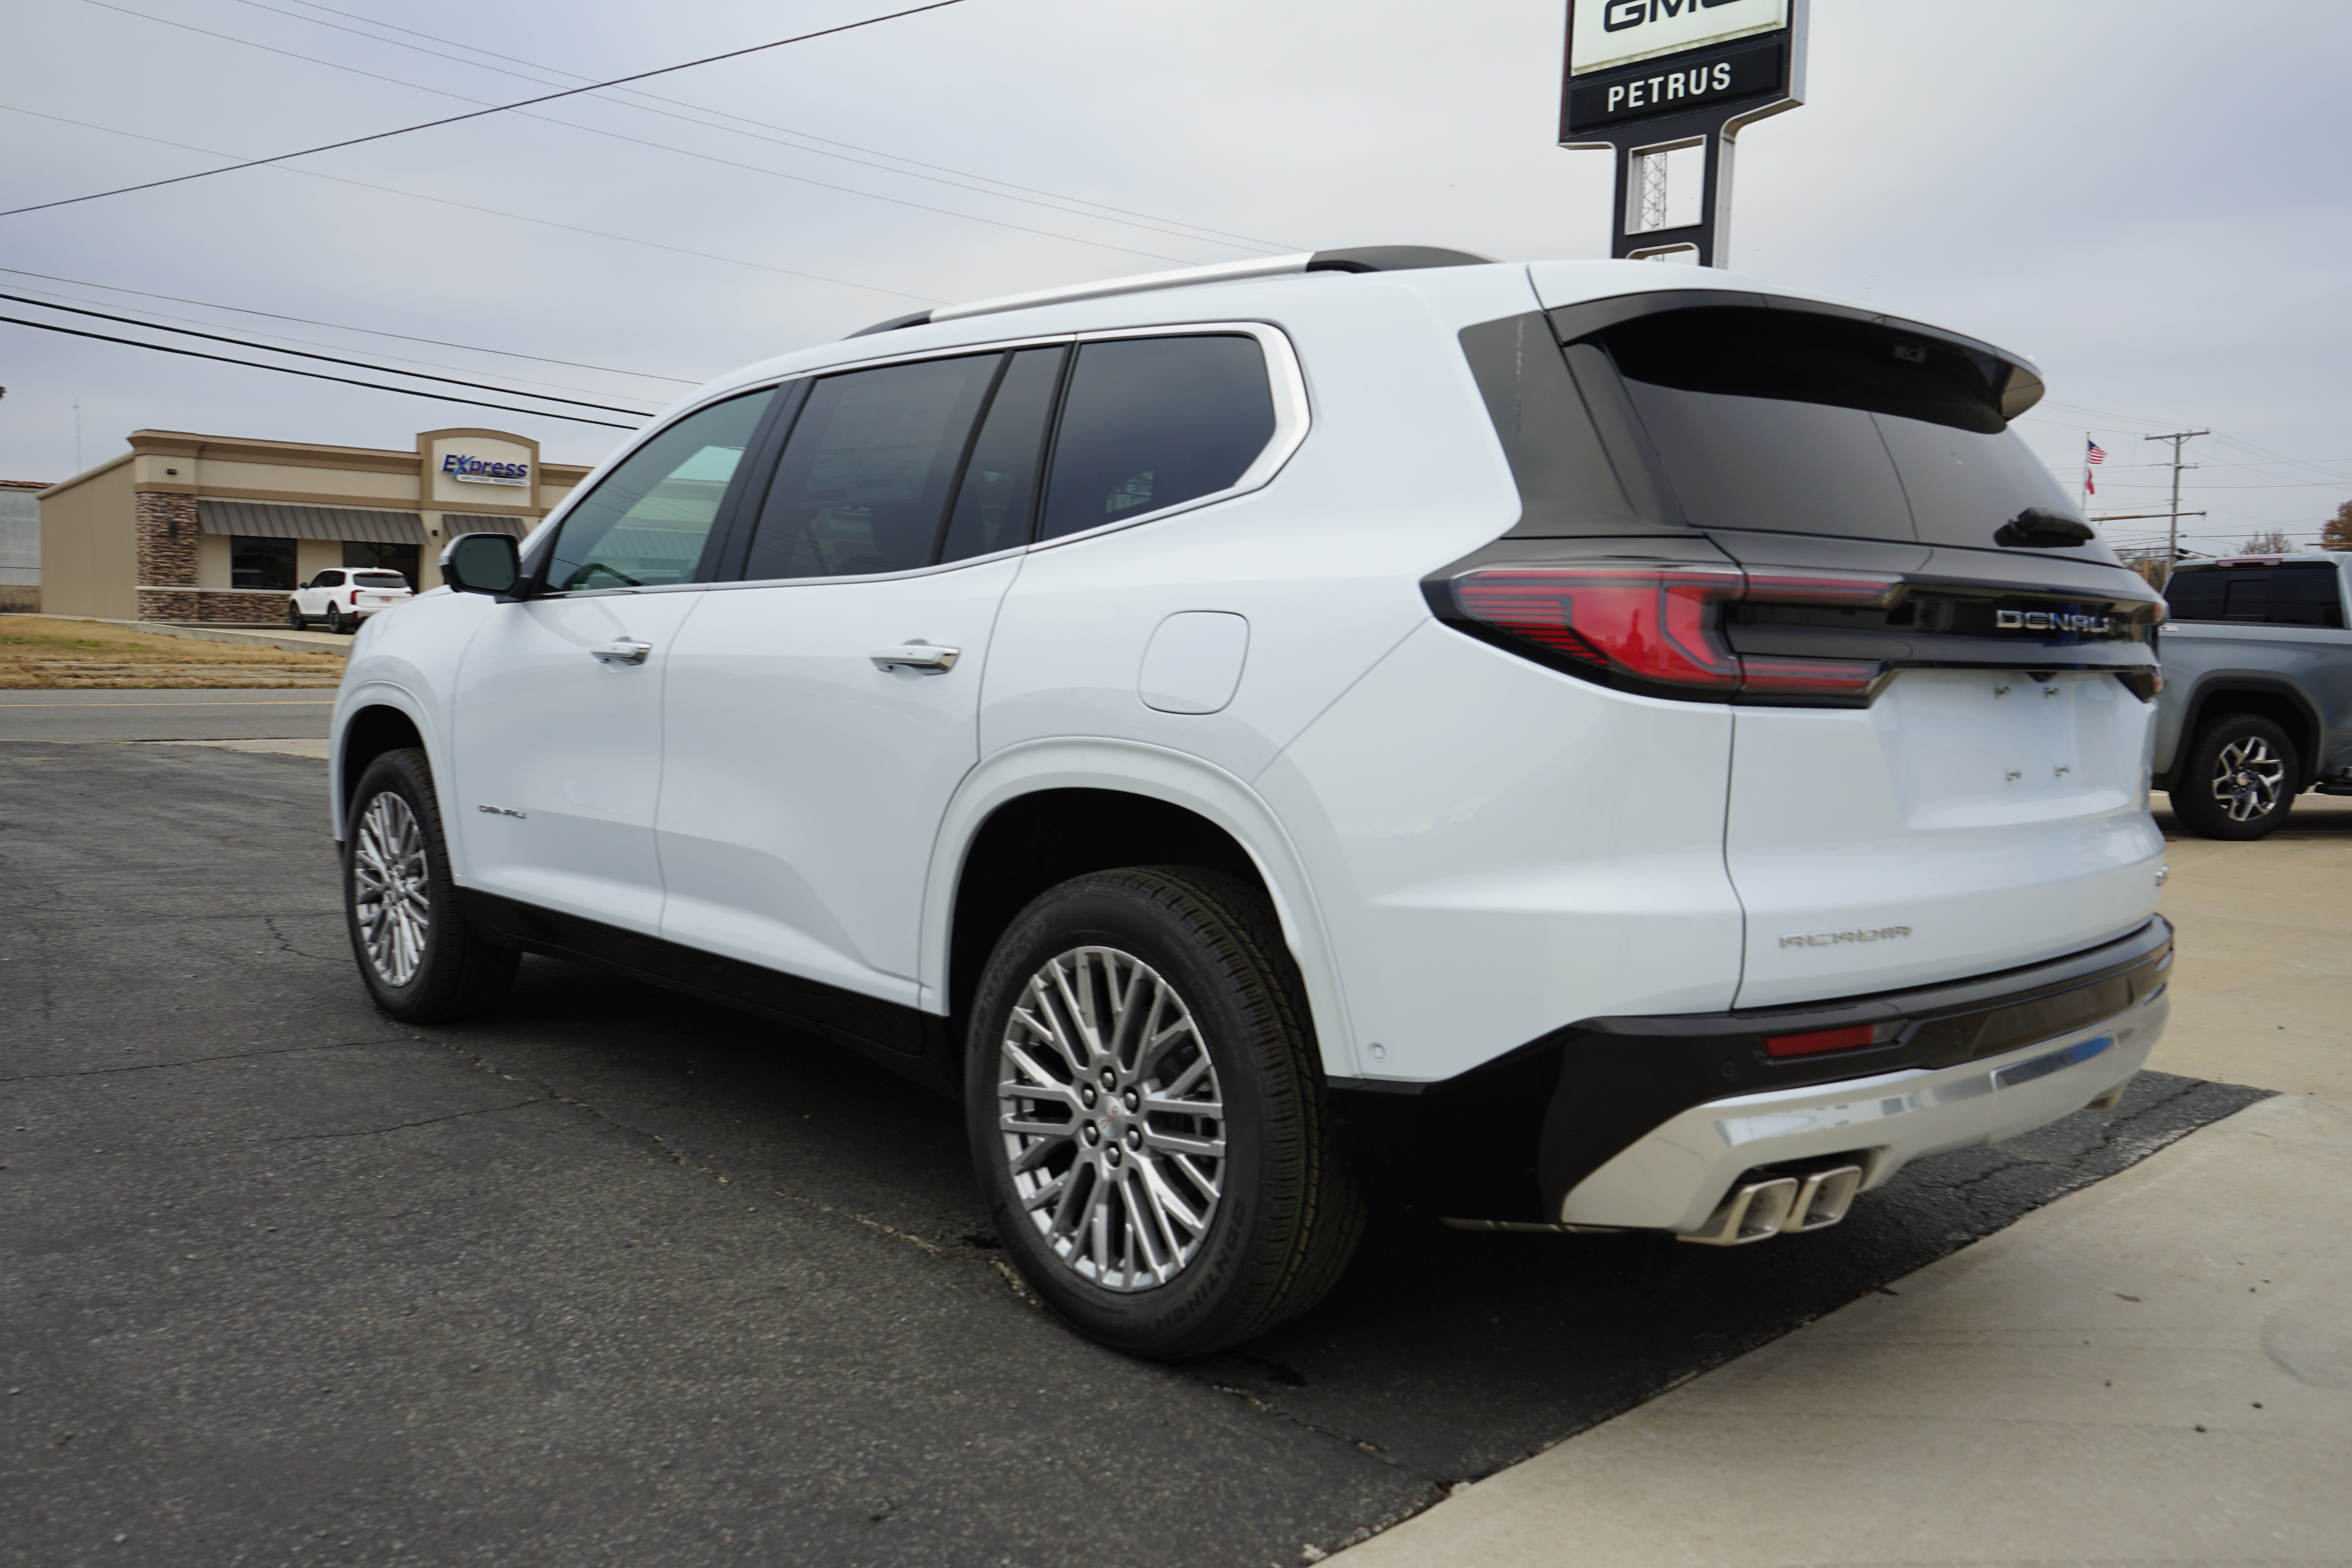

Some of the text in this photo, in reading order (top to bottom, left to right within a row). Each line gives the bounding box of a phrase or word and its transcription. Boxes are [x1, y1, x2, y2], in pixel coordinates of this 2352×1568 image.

[1604, 0, 1743, 33] GM
[1608, 63, 1731, 112] PETRUS
[1996, 610, 2111, 633] DENALI
[1779, 924, 1912, 948] ACADIA
[1121, 1196, 1247, 1333] CONTINENTA
